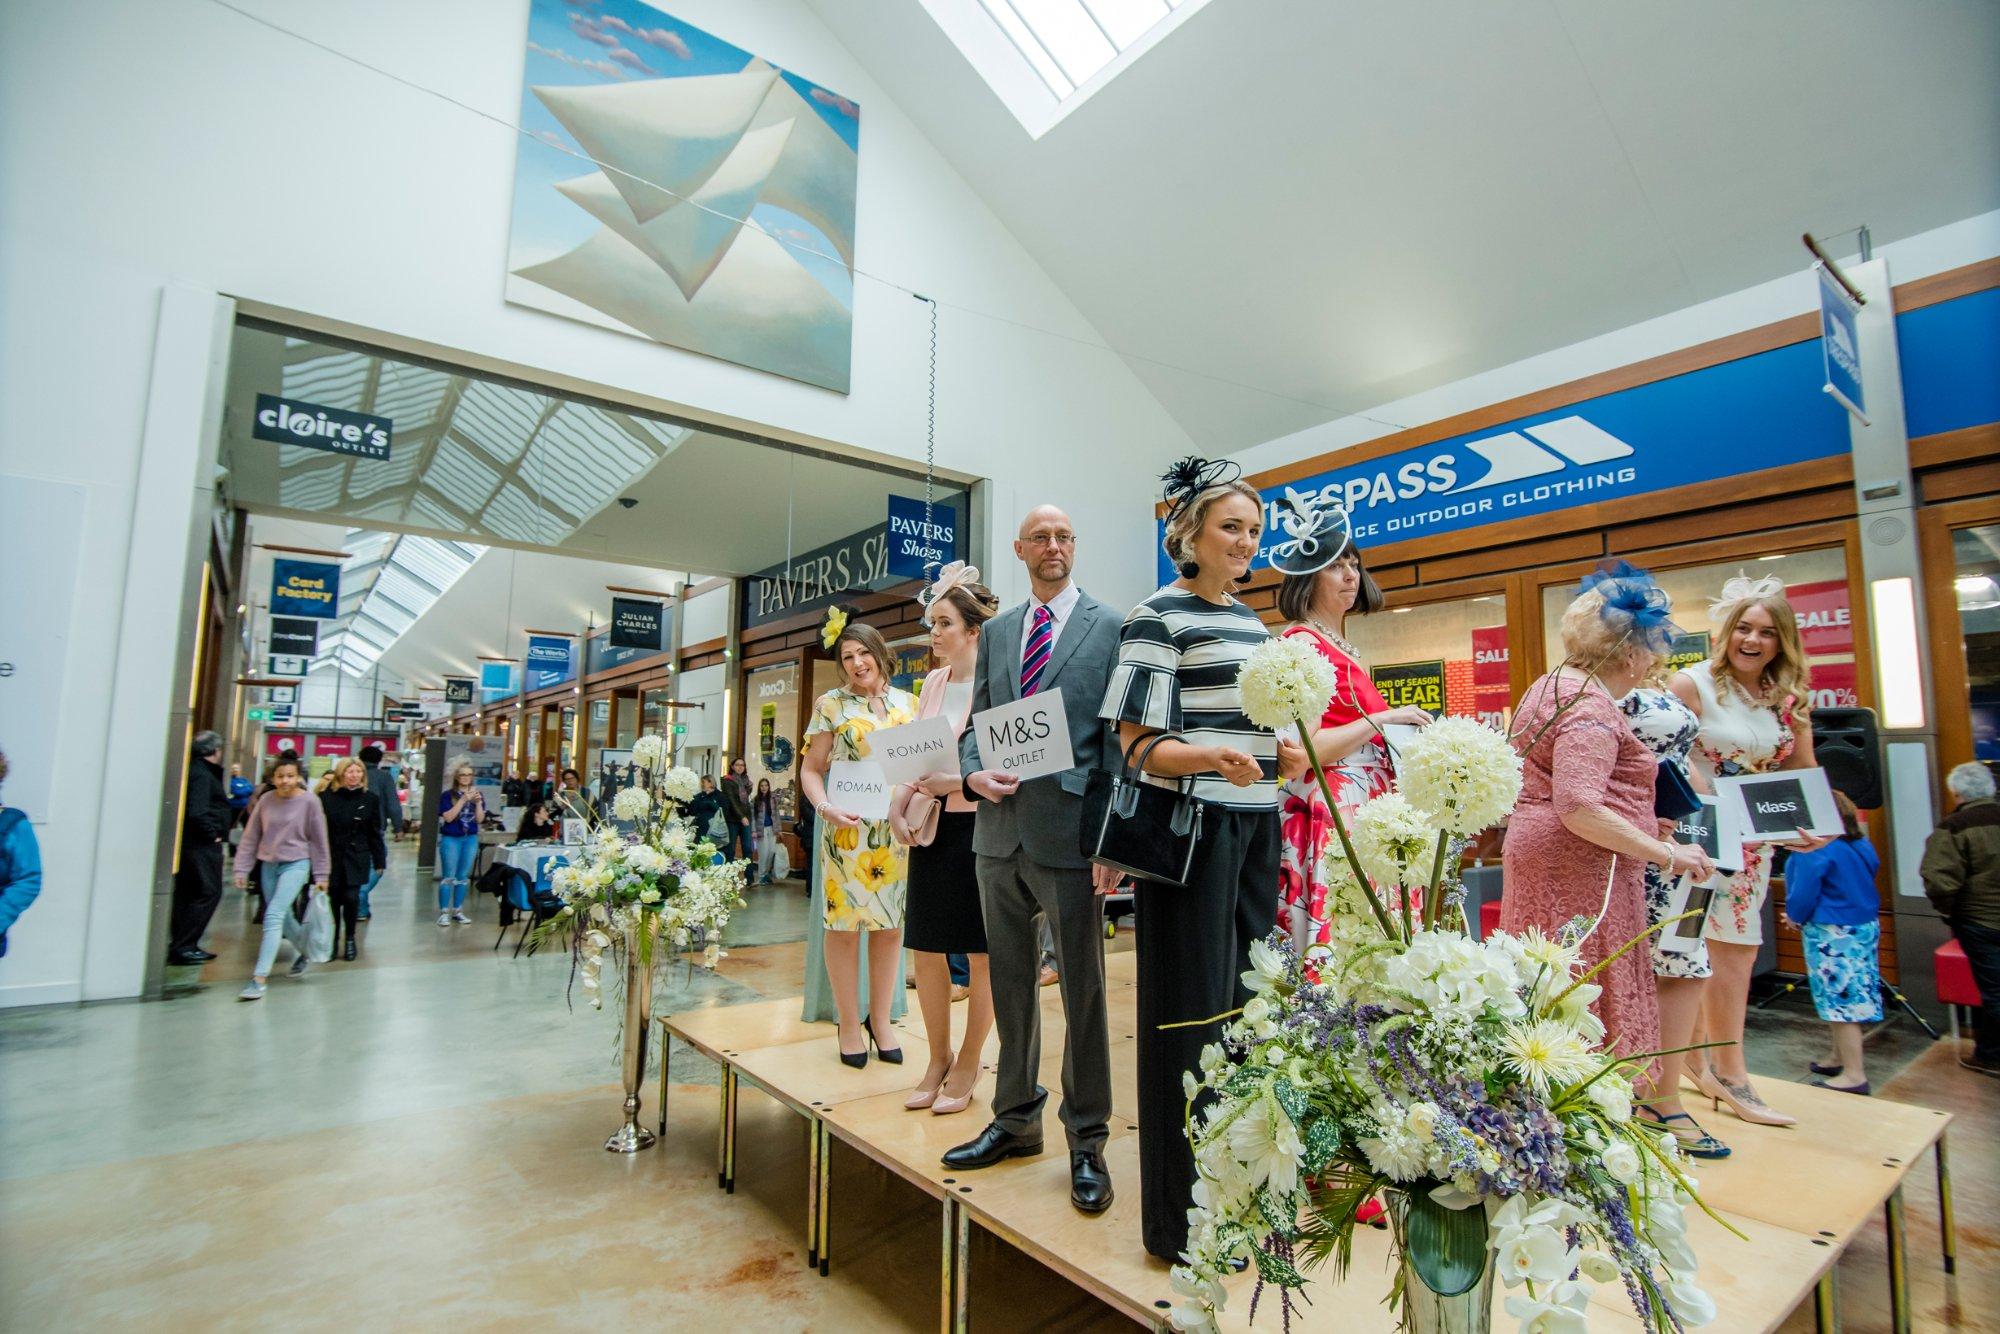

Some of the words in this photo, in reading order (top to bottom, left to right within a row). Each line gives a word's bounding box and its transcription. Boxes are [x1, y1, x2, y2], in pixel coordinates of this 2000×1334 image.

[258, 404, 388, 447] claire's
[331, 440, 385, 456] OUTLET
[1386, 498, 1493, 531] OUTDOOR
[1502, 467, 1636, 508] CLOTHING
[891, 515, 954, 543] PAVERS
[901, 539, 943, 561] Shoes
[288, 576, 325, 589] Card
[757, 547, 850, 617] PAVERS
[276, 586, 333, 603] Factory
[616, 619, 658, 630] CHARLES
[621, 612, 654, 622] JULIAN
[1794, 608, 1851, 630] SALE
[532, 648, 544, 656] The
[545, 649, 567, 658] Works
[1475, 648, 1509, 664] SALE
[1663, 651, 1704, 664] EASON
[1376, 680, 1393, 688] END
[1394, 679, 1406, 688] OF
[1407, 676, 1440, 687] SEASON
[989, 710, 1051, 752] M&S
[886, 738, 944, 759] ROMAN
[1002, 748, 1046, 770] OUTLET
[836, 780, 883, 793] ROMAN
[1756, 801, 1798, 814] klass
